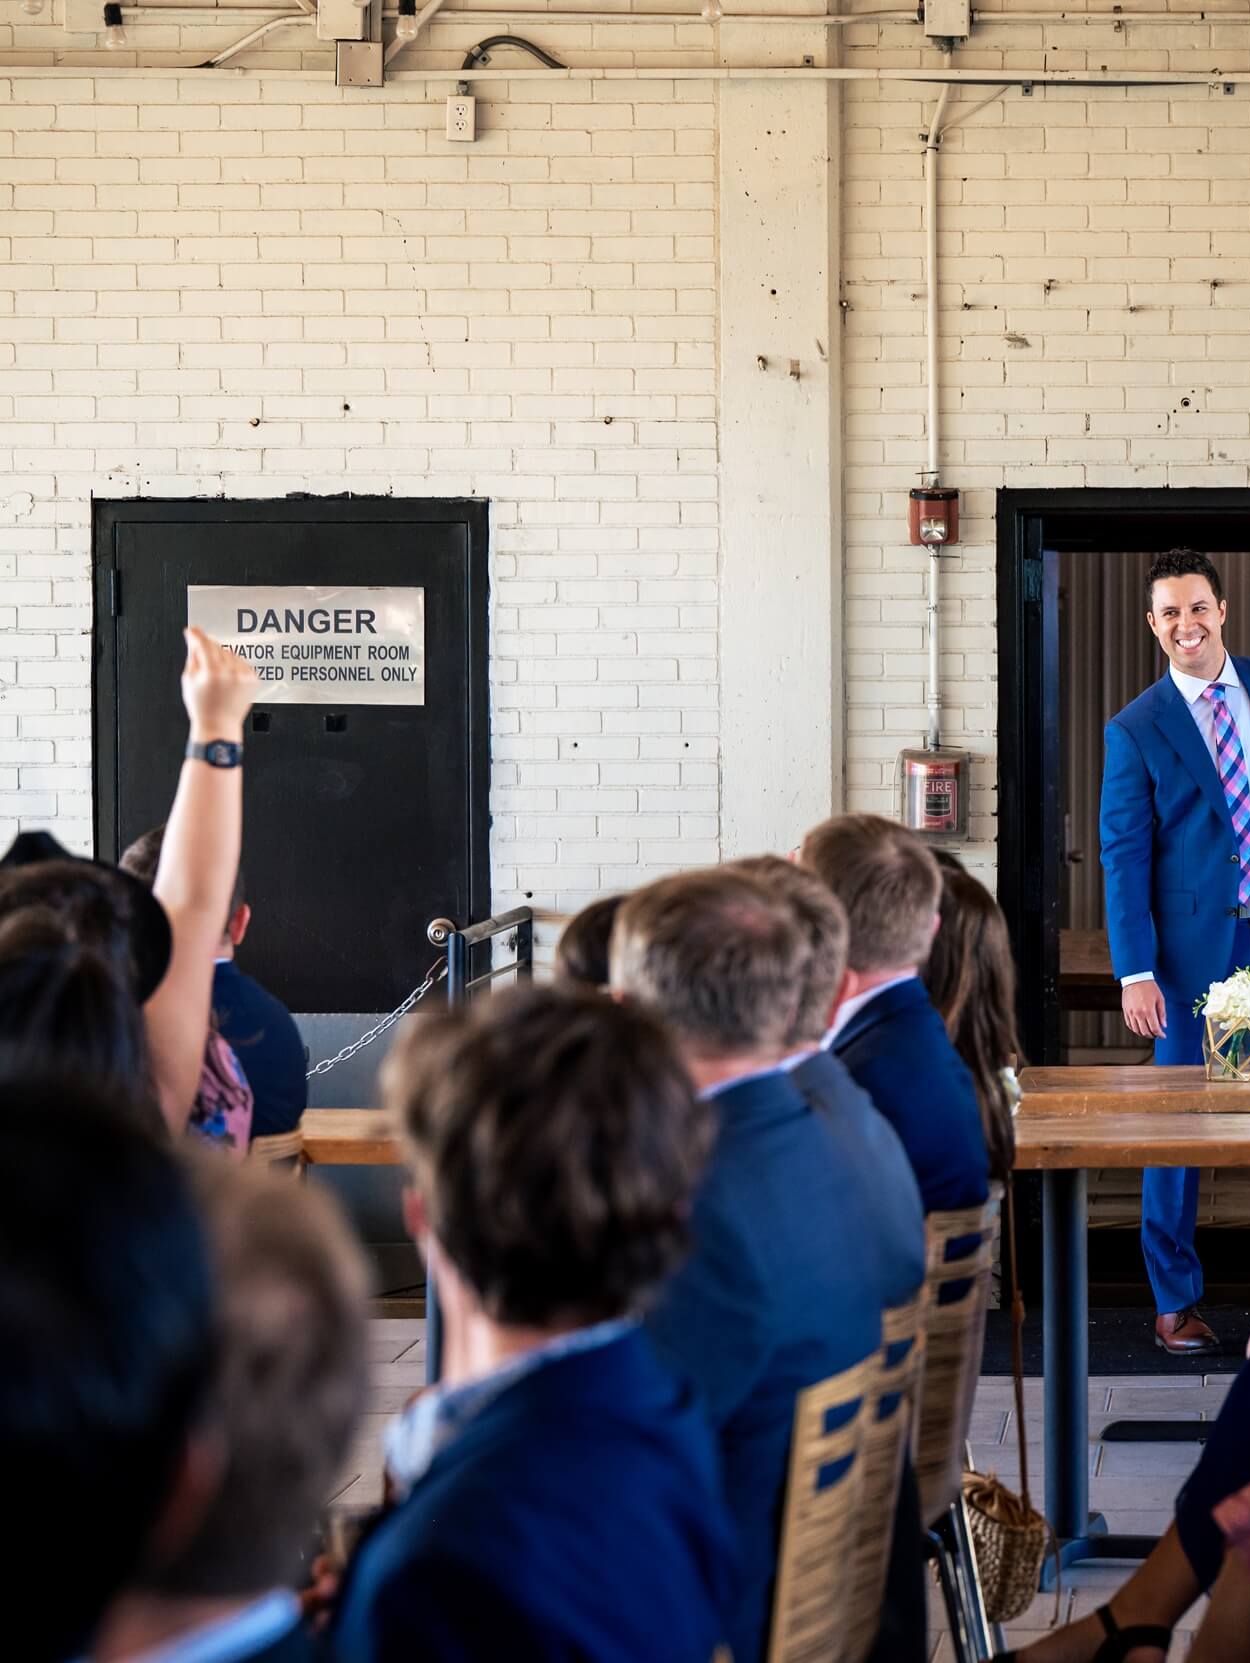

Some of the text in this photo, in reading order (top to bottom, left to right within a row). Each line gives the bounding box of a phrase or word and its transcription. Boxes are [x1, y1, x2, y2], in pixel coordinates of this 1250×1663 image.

[236, 608, 377, 634] DANGER
[221, 644, 410, 661] VATOR EQUIPMENT ROOM
[291, 666, 375, 681] PERSONNEL
[381, 667, 417, 682] ONLY
[924, 781, 952, 793] FIRE
